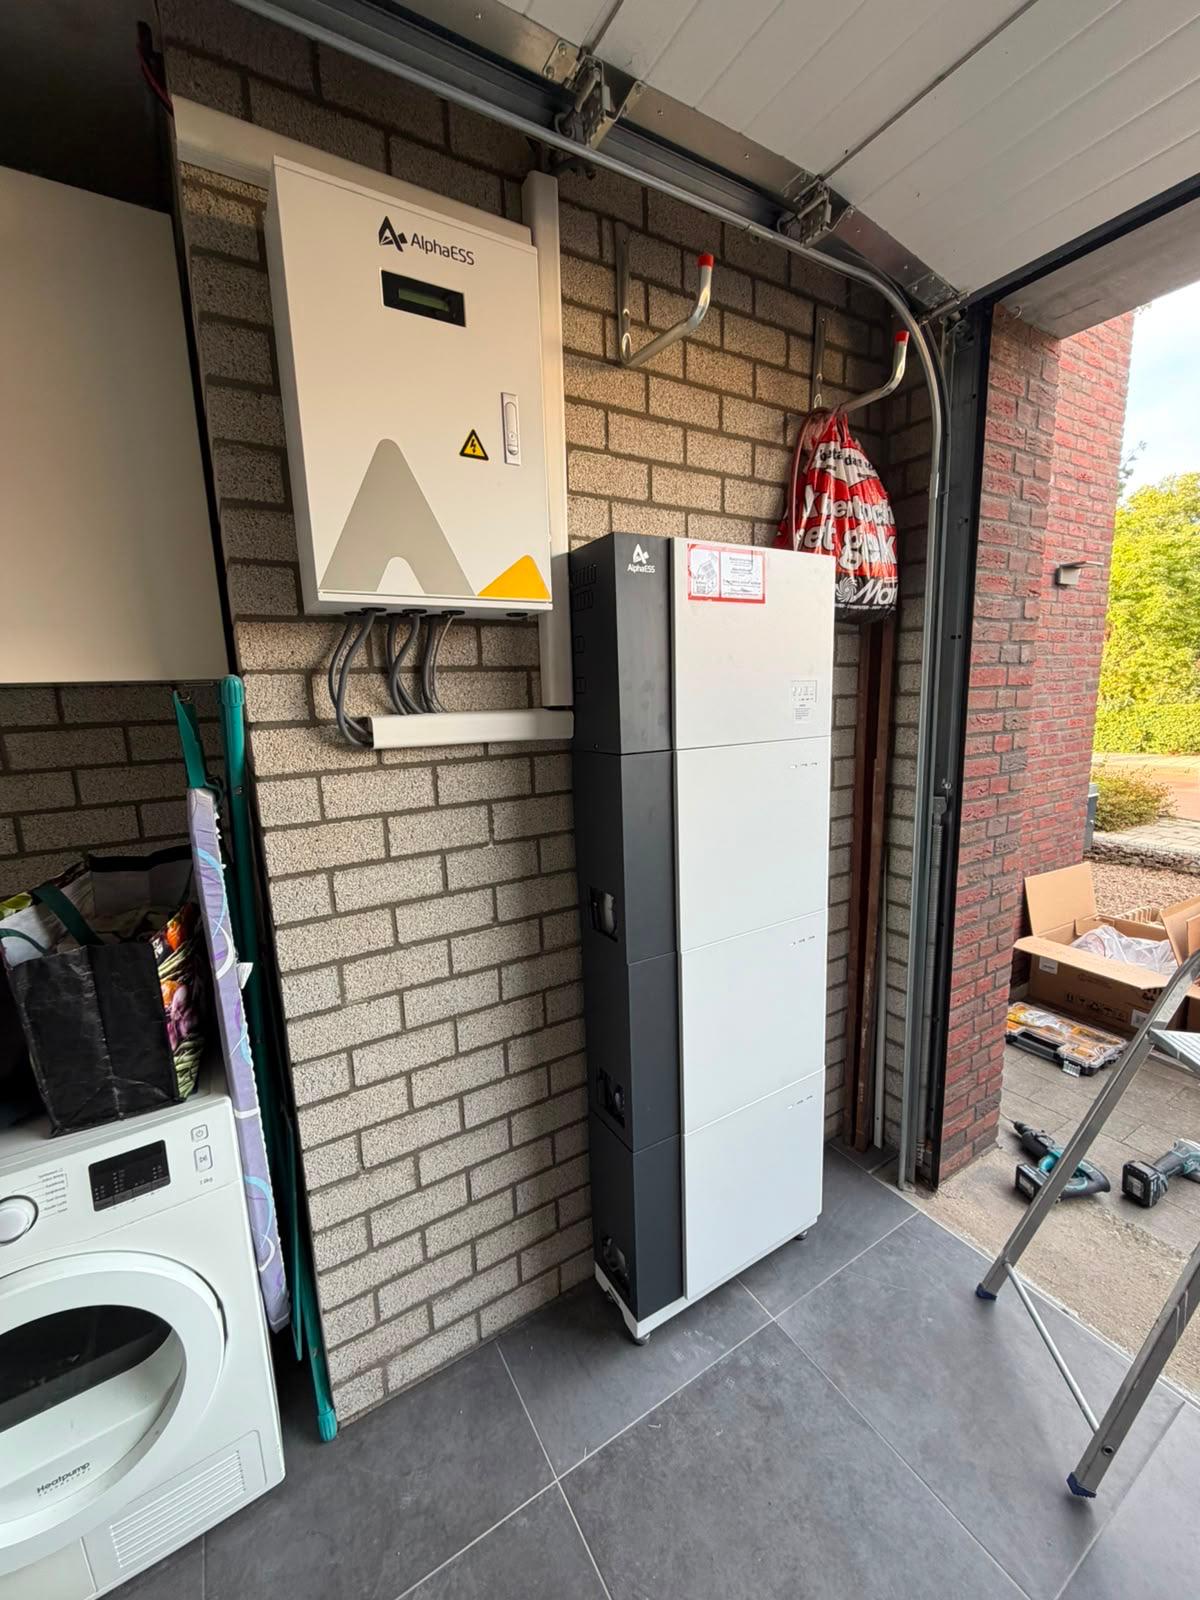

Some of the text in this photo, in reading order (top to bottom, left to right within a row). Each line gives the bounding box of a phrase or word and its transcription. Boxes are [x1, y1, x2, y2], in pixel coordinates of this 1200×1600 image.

[410, 232, 475, 266] AlphaESS
[627, 563, 656, 574] AlphaESS
[36, 1461, 90, 1494] Heatpump
